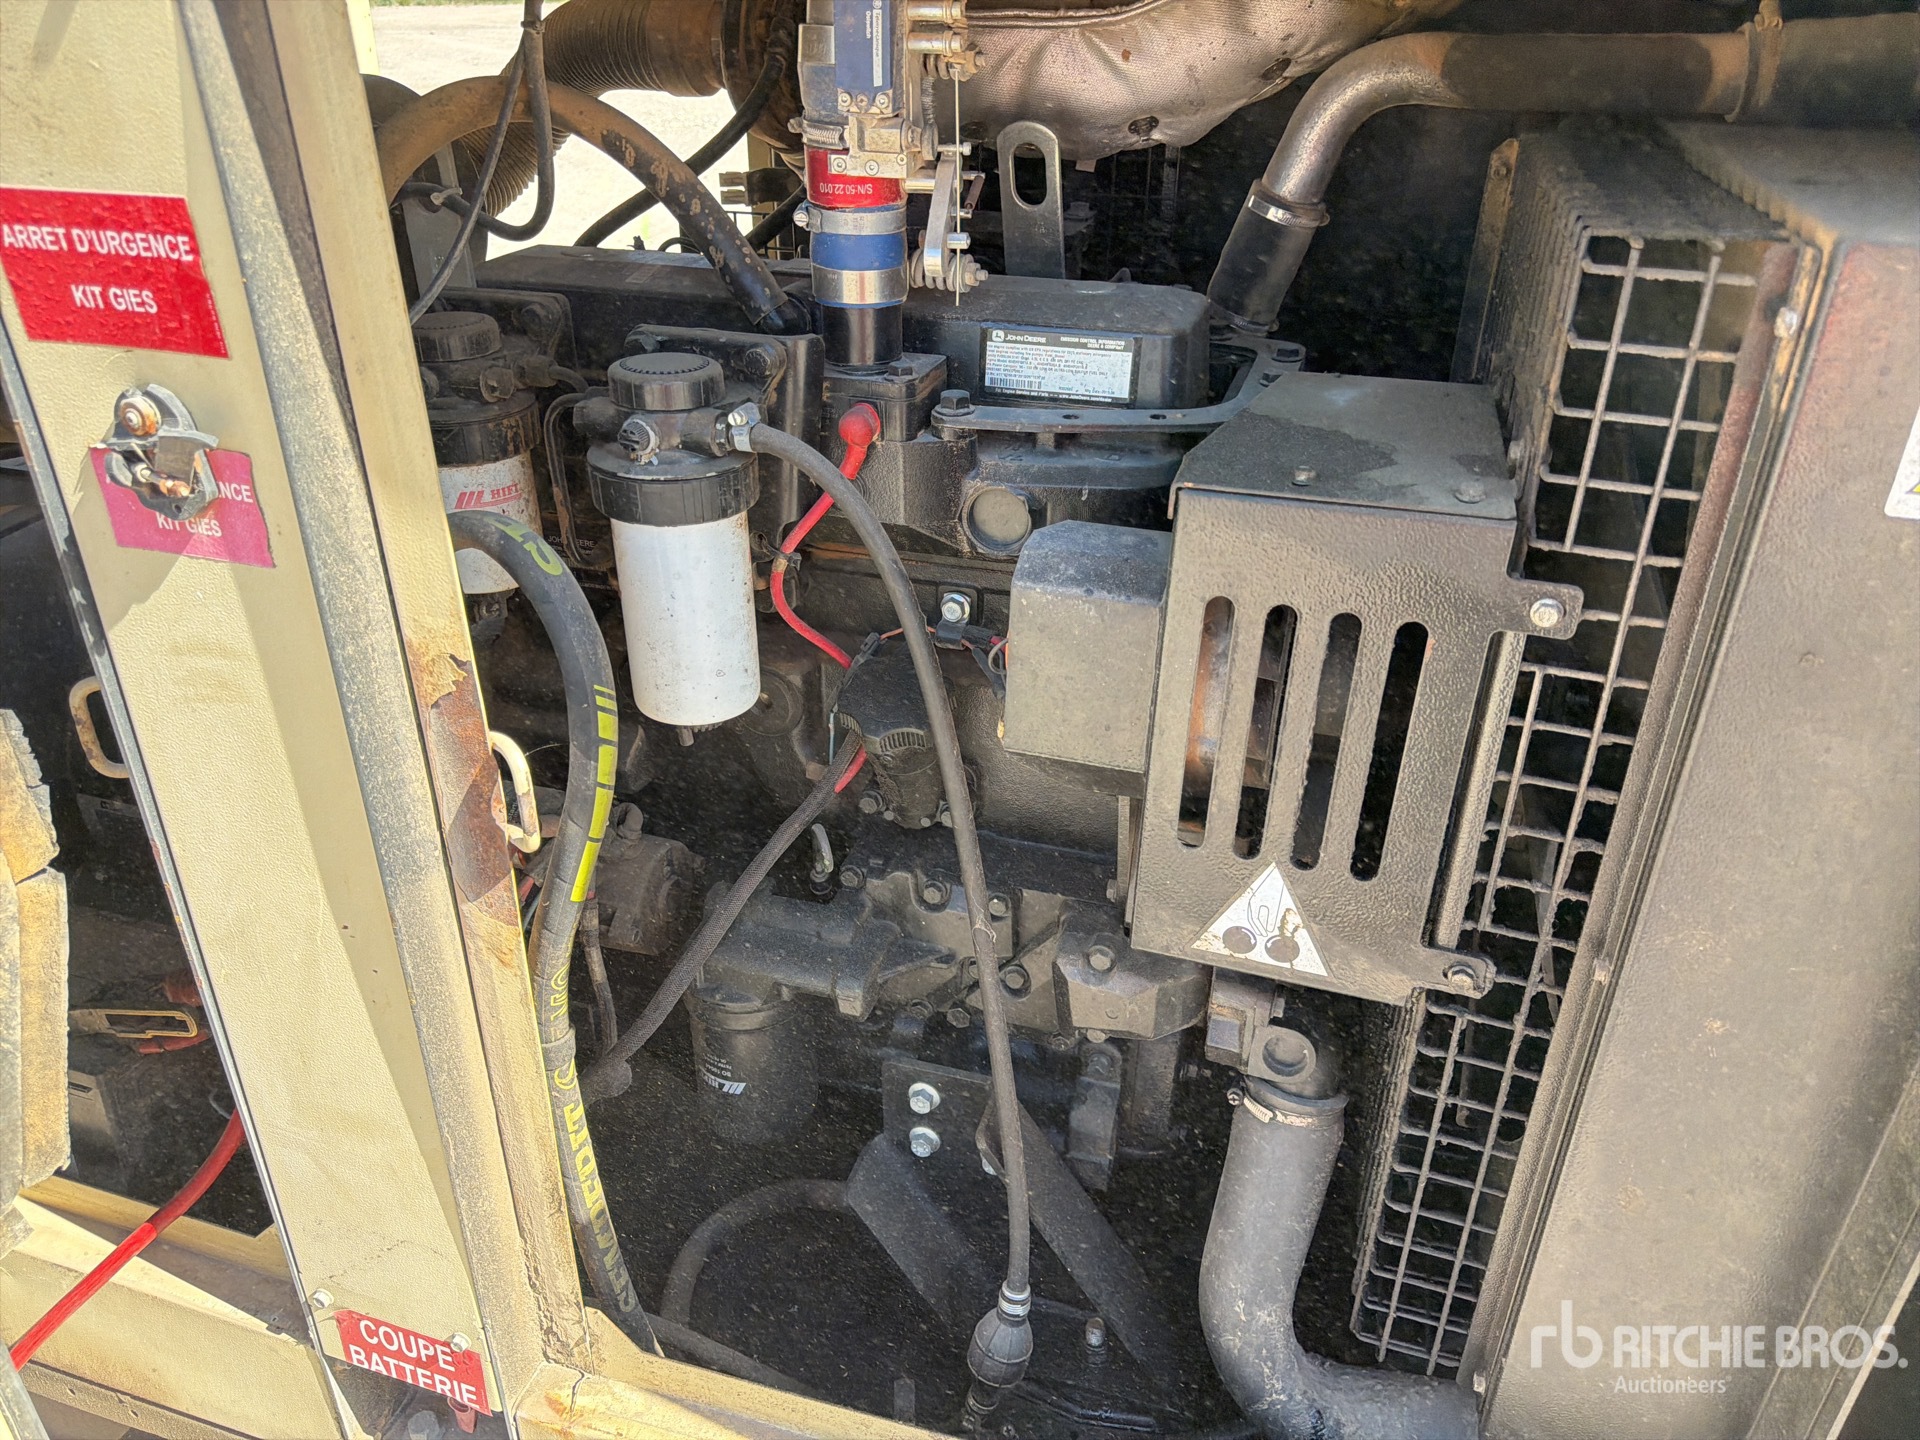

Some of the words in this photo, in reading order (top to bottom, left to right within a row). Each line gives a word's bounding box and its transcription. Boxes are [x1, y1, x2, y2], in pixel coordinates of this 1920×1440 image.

[3, 223, 68, 253] ARRET
[72, 228, 194, 261] D'URGENCE
[71, 284, 104, 309] KIT
[109, 287, 158, 315] GIES
[1005, 333, 1023, 341] JOHN
[185, 518, 222, 537] GIES
[359, 1319, 456, 1373] COUPE
[349, 1344, 480, 1409] BATTERIE
